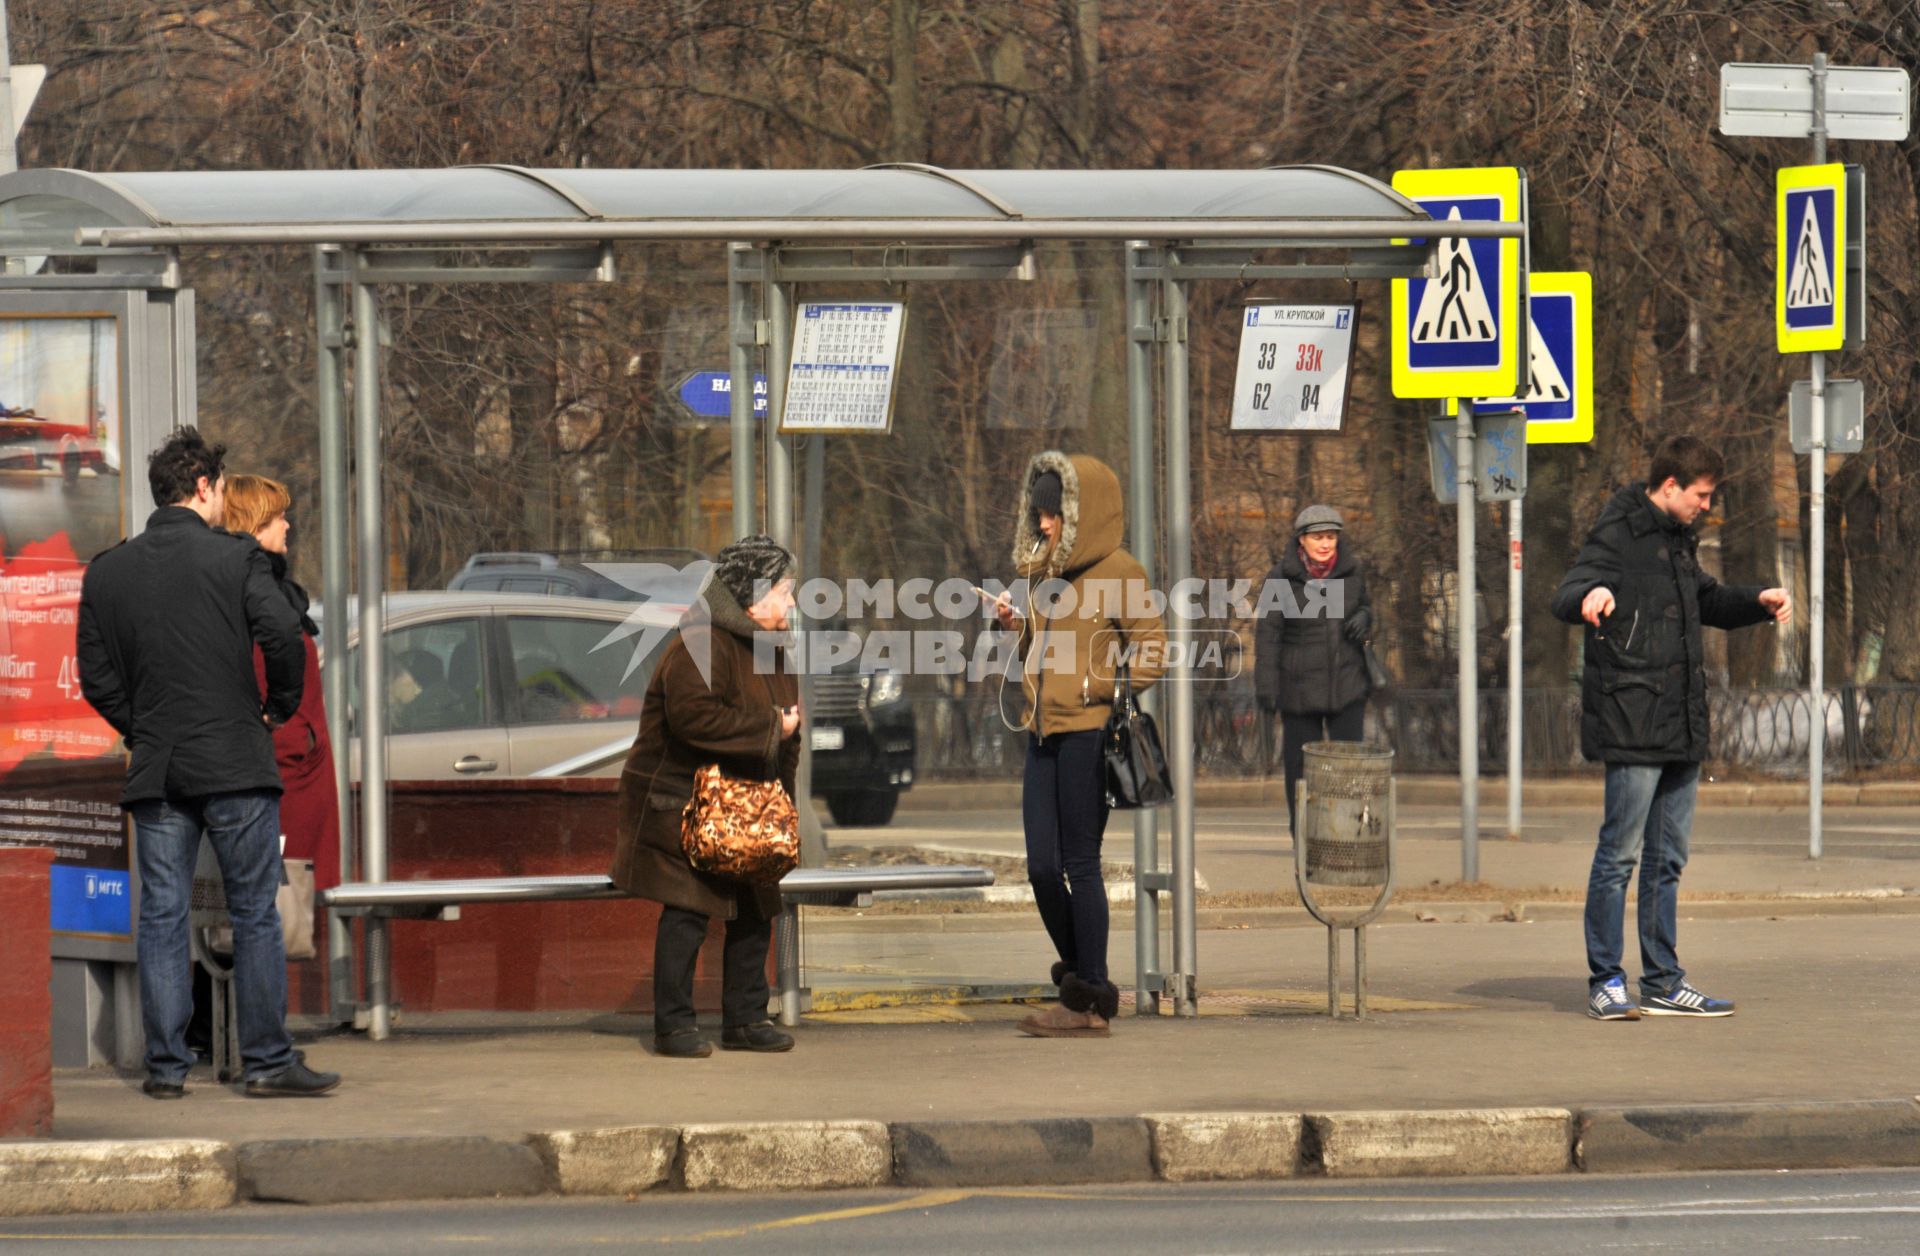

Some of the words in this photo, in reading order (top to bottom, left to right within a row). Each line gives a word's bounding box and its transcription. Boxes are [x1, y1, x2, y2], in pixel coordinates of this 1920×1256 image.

[1274, 309, 1285, 320] УЛ.
[1287, 308, 1325, 321] КРУПСКОЙ
[1258, 342, 1277, 370] 33
[1252, 382, 1271, 411] 62
[1301, 384, 1321, 413] 84
[98, 880, 123, 896] МГТС
